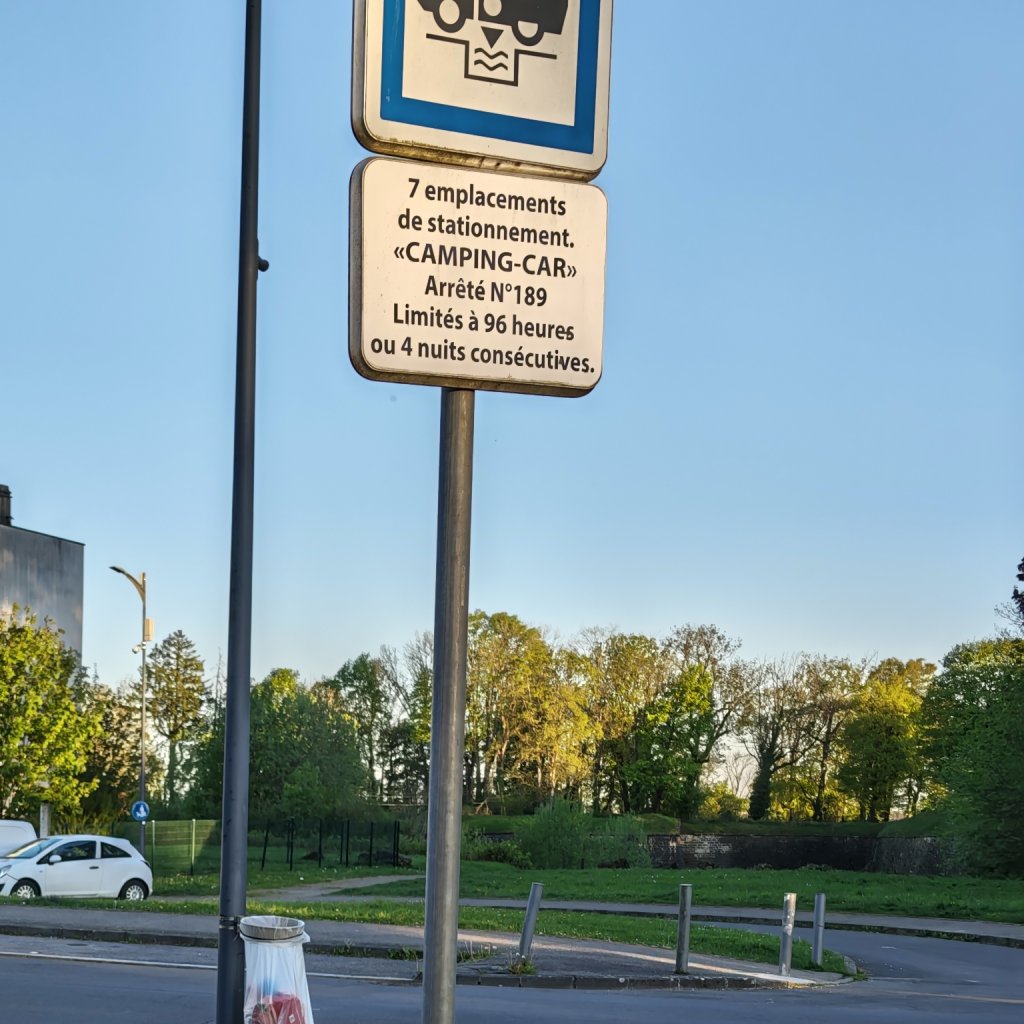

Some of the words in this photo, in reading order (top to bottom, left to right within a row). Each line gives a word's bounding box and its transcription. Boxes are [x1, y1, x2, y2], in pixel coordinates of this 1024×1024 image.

[408, 178, 420, 199] 7
[424, 183, 566, 216] emplacements
[398, 208, 422, 231] de
[427, 215, 575, 249] stationnement.
[394, 242, 577, 279] «CAMPING-CAR»
[424, 275, 485, 301] Arrêté
[490, 282, 547, 307] N°189
[393, 303, 463, 331] Limités
[468, 310, 479, 332] à
[484, 313, 507, 335] 96
[512, 314, 574, 341] heures
[370, 338, 396, 355] ou
[401, 336, 413, 356] 4
[417, 339, 466, 362] nuits
[470, 346, 595, 374] consécutives.
